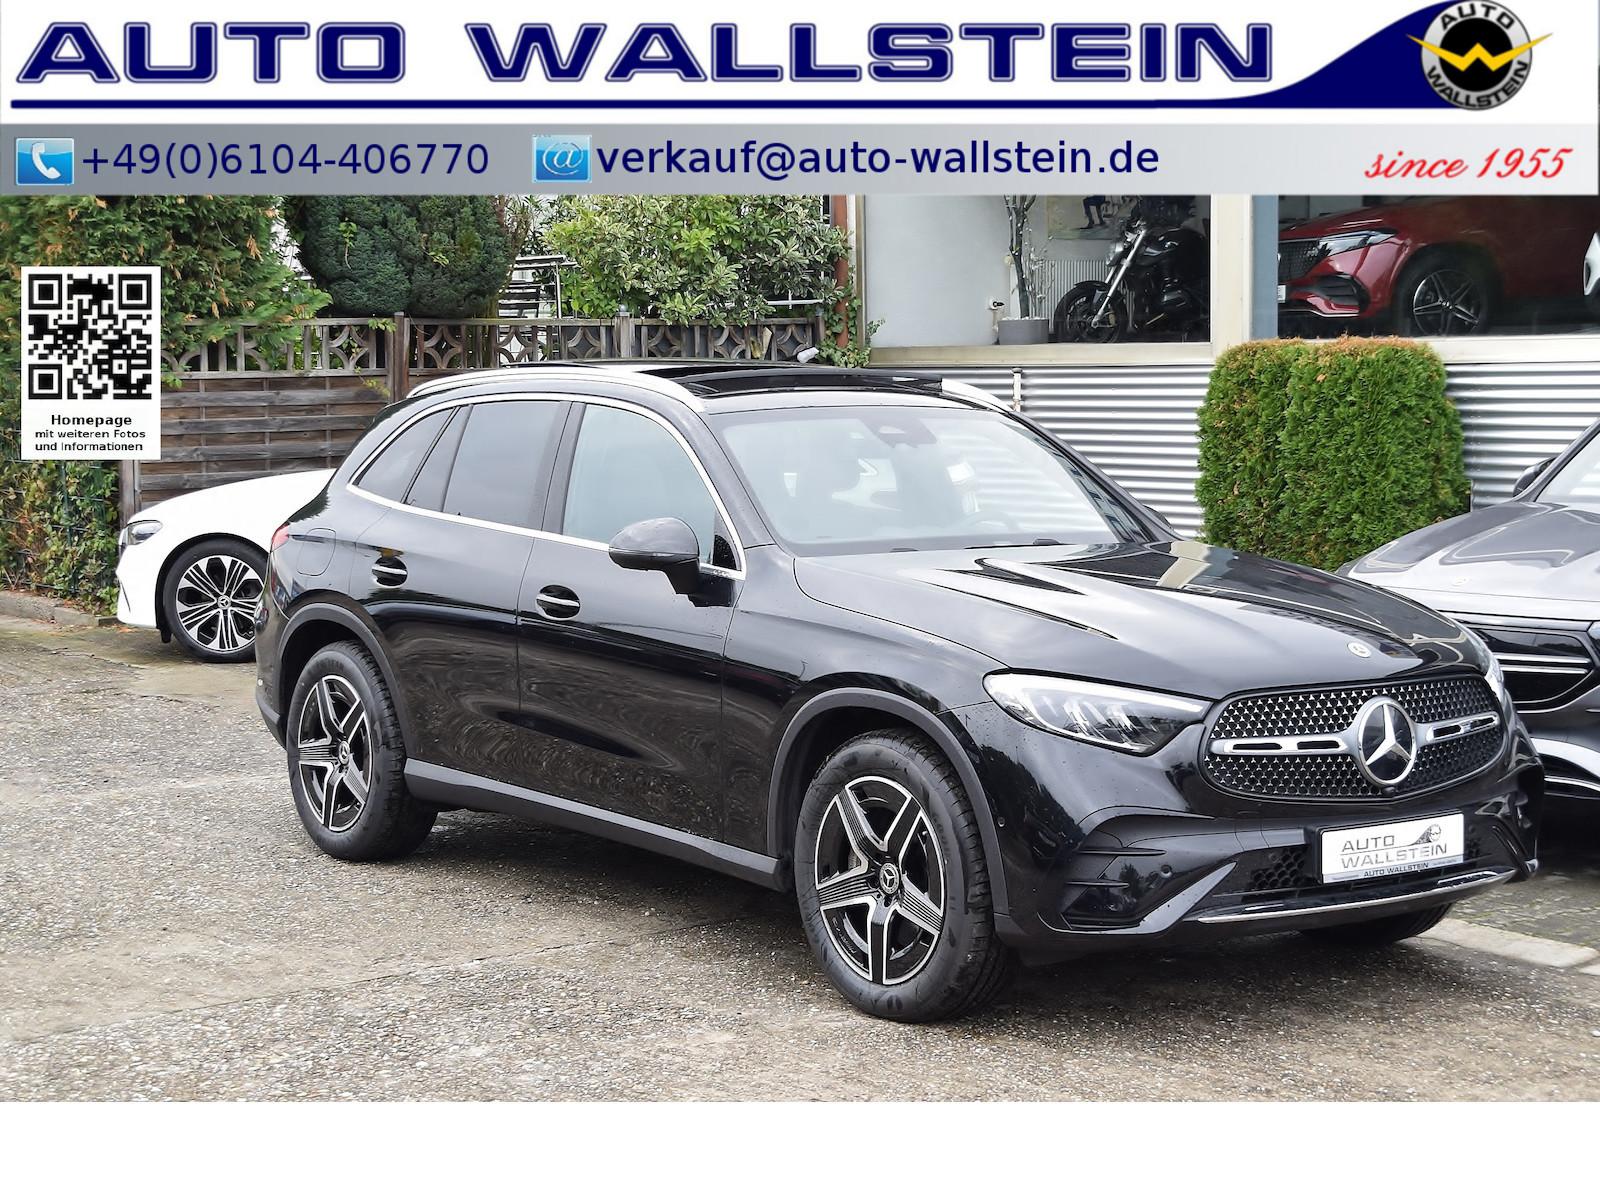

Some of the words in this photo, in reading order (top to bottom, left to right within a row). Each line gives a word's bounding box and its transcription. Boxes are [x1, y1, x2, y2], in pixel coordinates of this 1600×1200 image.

[1342, 835, 1395, 853] AUTO
[1340, 843, 1448, 869] WALLSTEIN
[1363, 869, 1385, 877] AUTO
[1386, 862, 1429, 874] WALLSTEIN
